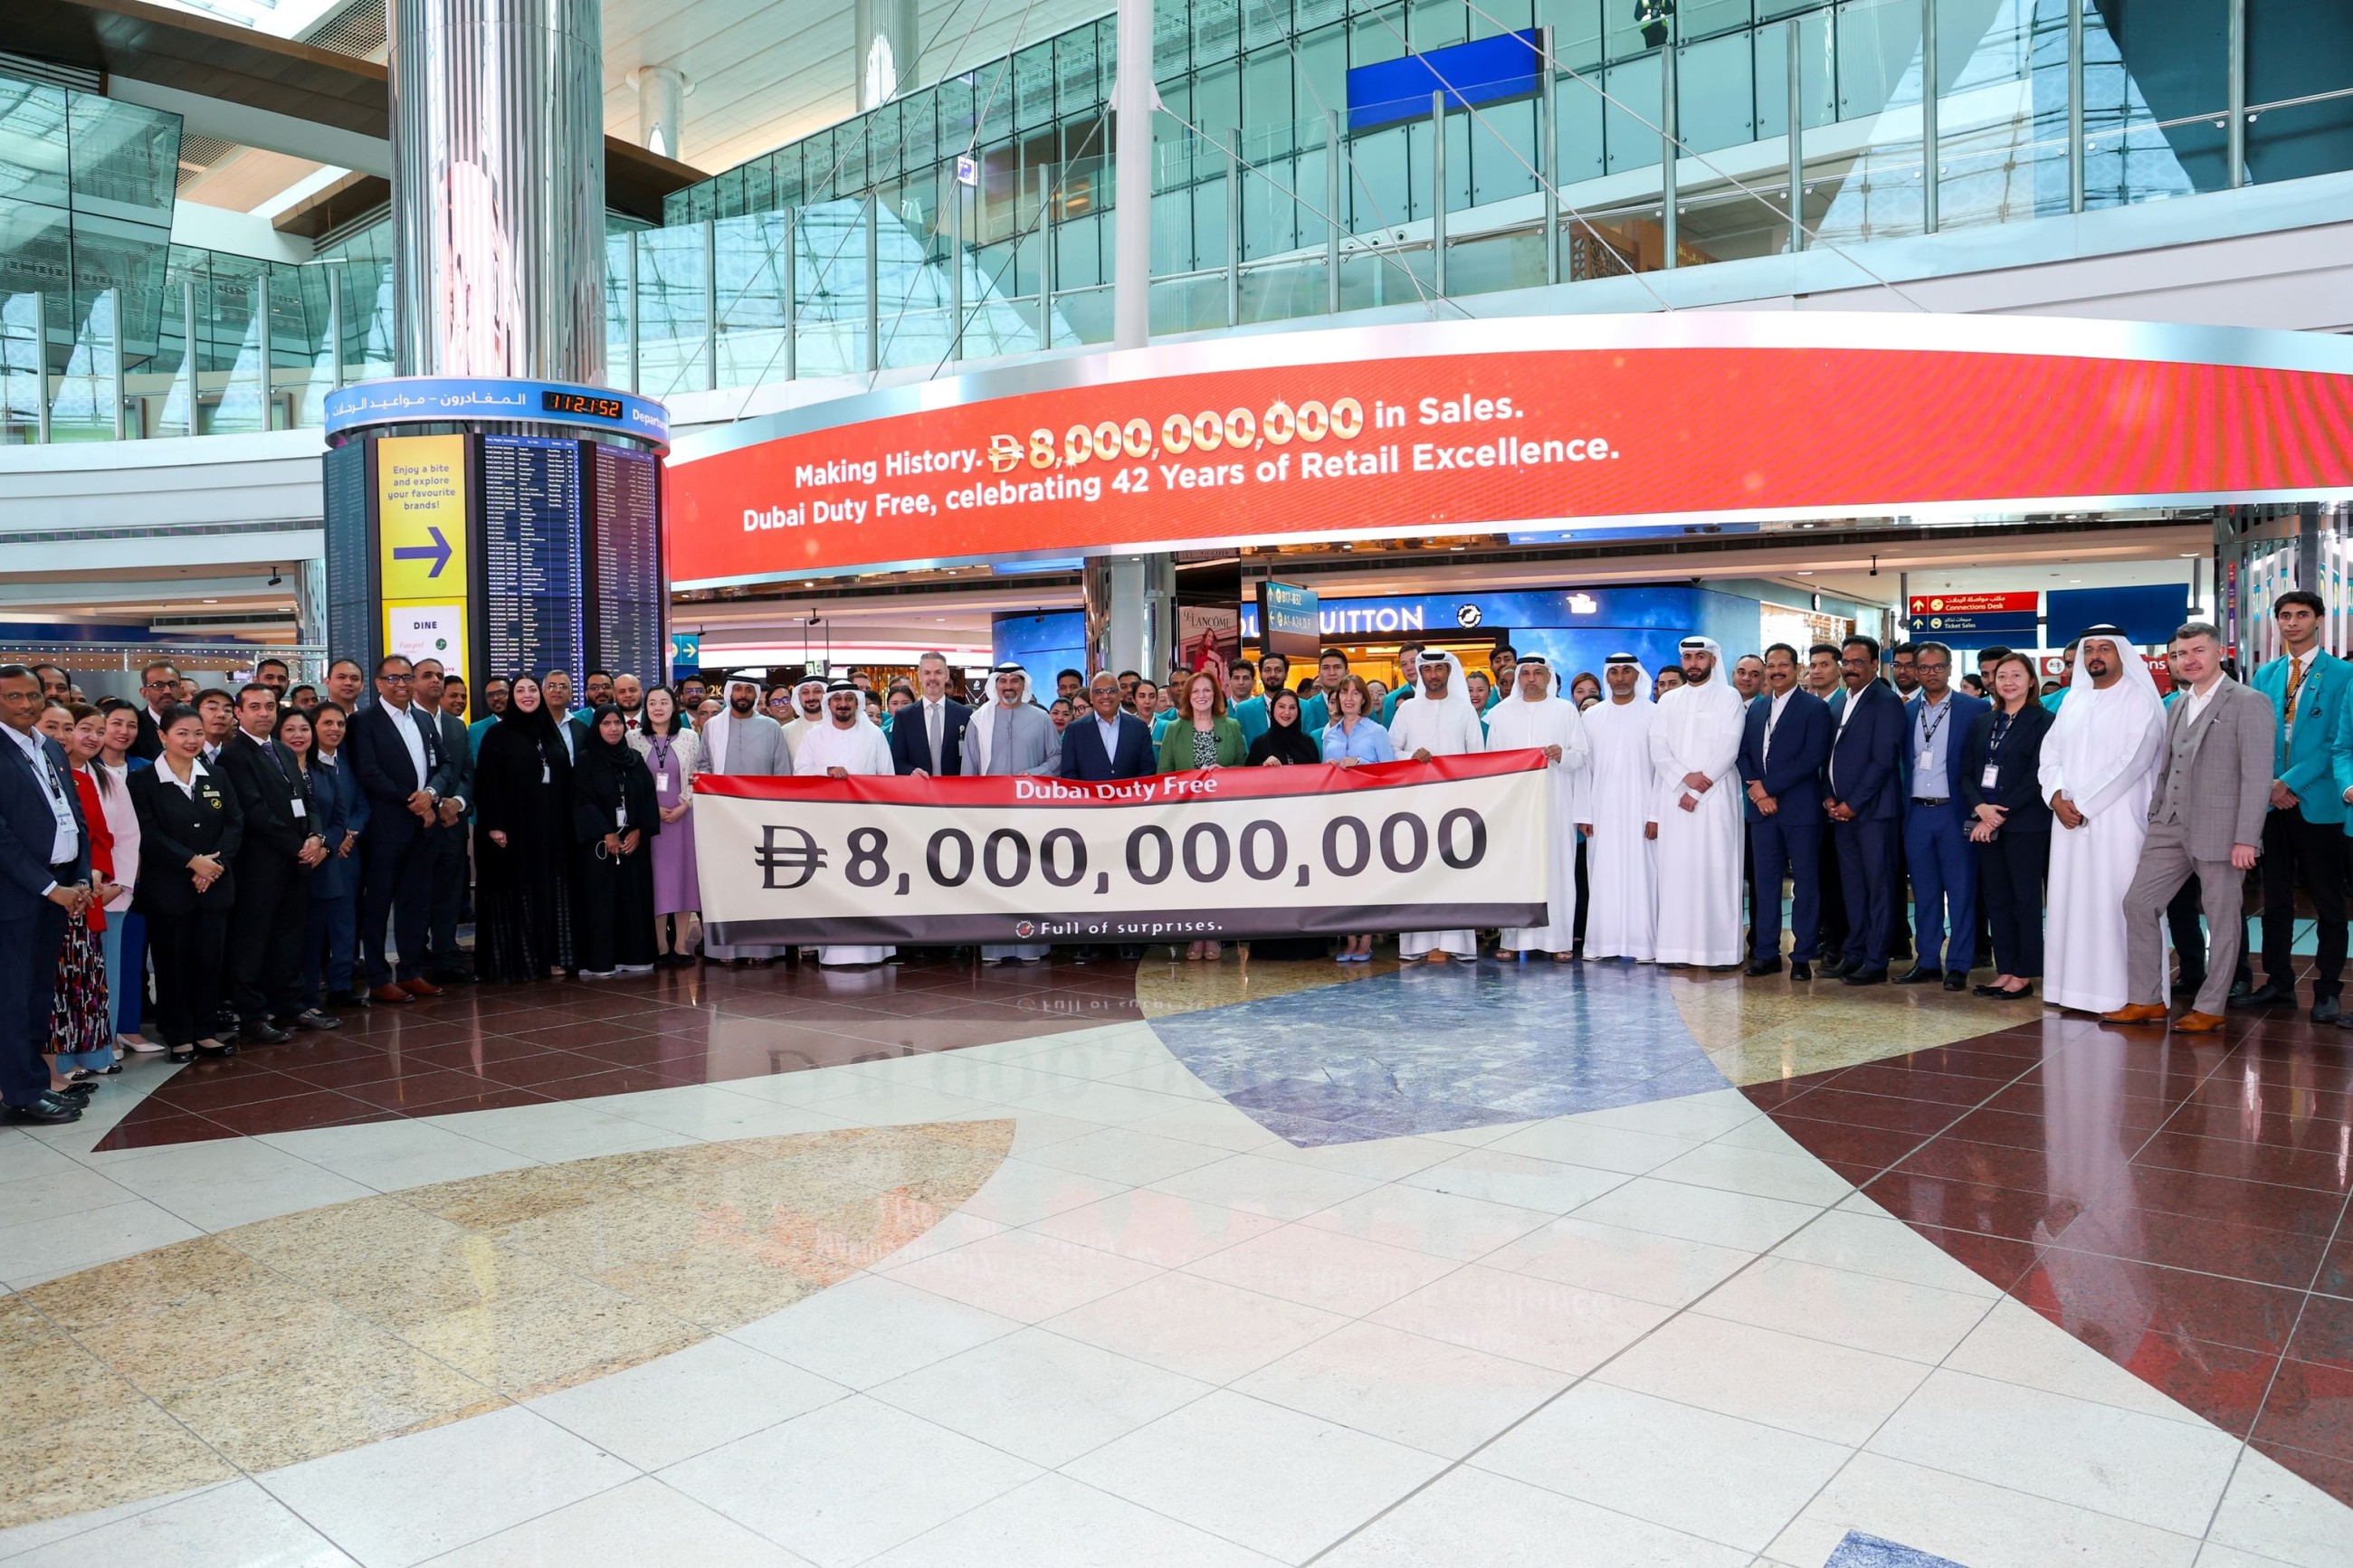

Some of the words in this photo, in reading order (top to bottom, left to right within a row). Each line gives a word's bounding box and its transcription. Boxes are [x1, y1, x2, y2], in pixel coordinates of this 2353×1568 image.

[795, 459, 877, 489] Making
[885, 449, 983, 478] History.
[1029, 397, 1364, 469] 8,000,000,000
[1375, 397, 1405, 429] in
[1418, 393, 1524, 425] Sales.
[393, 465, 419, 476] Enjoy
[430, 464, 450, 472] bite
[393, 478, 411, 487] and
[413, 477, 450, 487] explore
[743, 502, 805, 532] Dubai
[813, 498, 868, 524] Duty
[875, 492, 937, 518] Free,
[945, 473, 1101, 510] celebrating
[1110, 467, 1149, 494] 42
[1159, 463, 1245, 490] Years
[1255, 452, 1291, 483] of
[1300, 444, 1399, 480] Retail
[1413, 436, 1619, 471] Excellence.
[387, 491, 409, 501] your
[412, 489, 456, 498] favourite
[404, 500, 440, 510] brands!
[1945, 603, 1986, 612] Connections
[414, 621, 437, 630] DINE
[1319, 605, 1424, 634] UITTON
[1015, 779, 1090, 800] Dubai
[1096, 781, 1156, 802] Duty
[1163, 775, 1218, 796] Free
[844, 807, 1488, 896] 8,000,000,000
[1040, 921, 1079, 935] Full
[1088, 921, 1109, 934] of
[1118, 920, 1224, 936] surprises.
